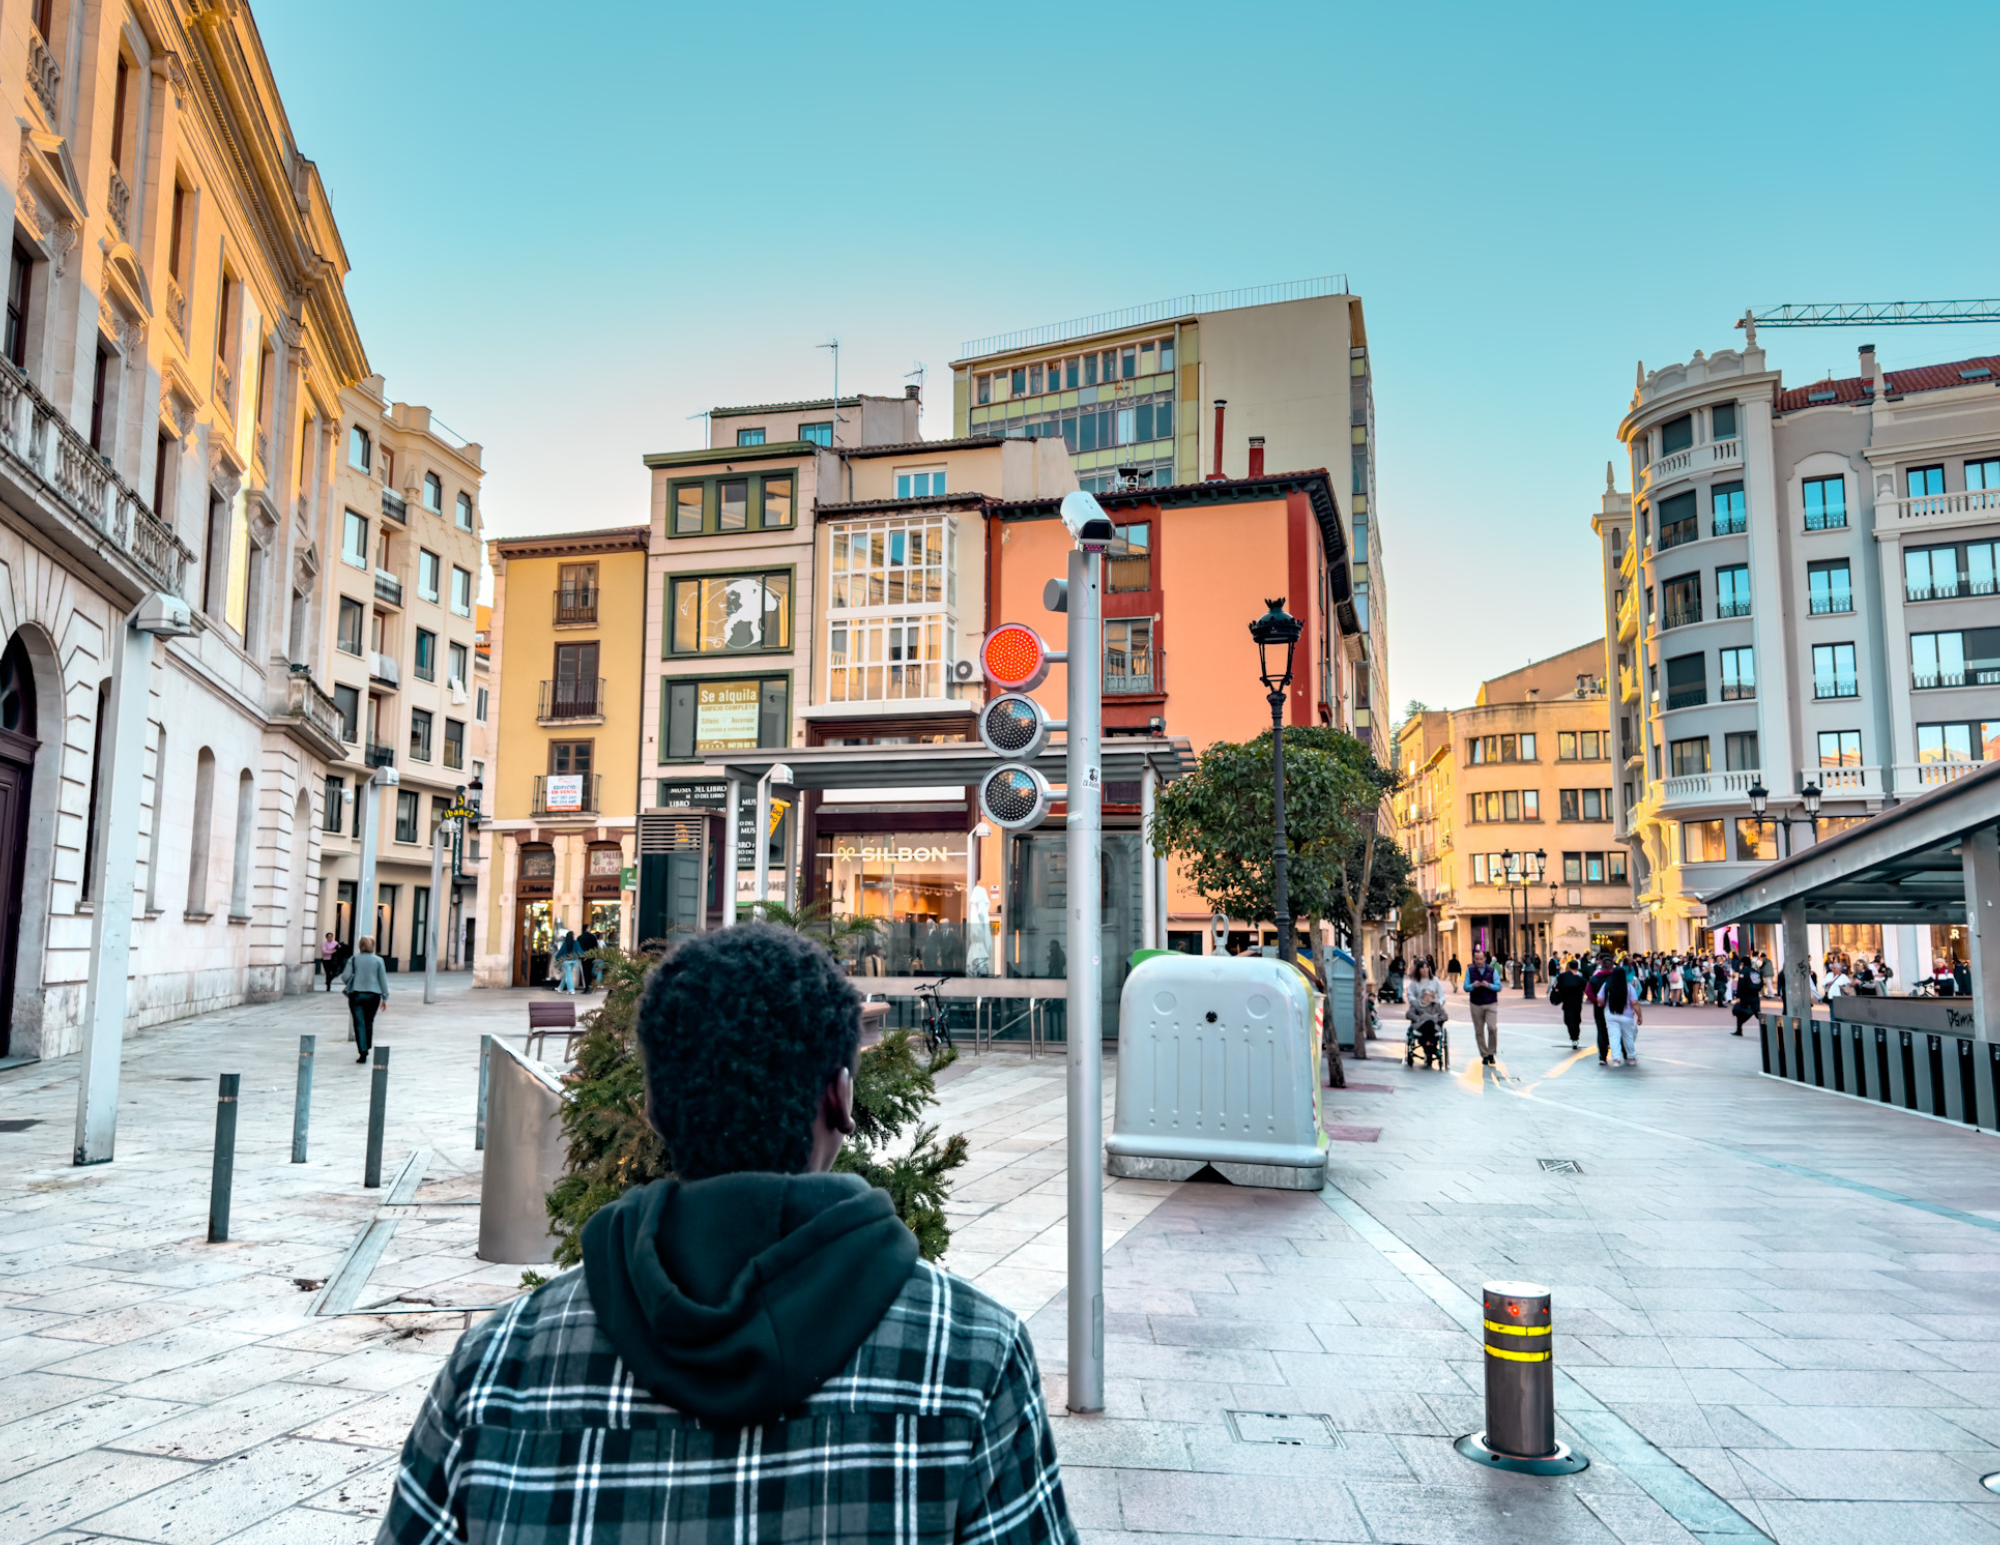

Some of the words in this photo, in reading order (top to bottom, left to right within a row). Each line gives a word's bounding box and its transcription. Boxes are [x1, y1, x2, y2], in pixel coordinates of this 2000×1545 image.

[701, 690, 715, 703] Se
[718, 688, 757, 704] alquila
[669, 800, 690, 808] LIBRO
[741, 798, 758, 806] MUS
[861, 846, 948, 862] SILBON
